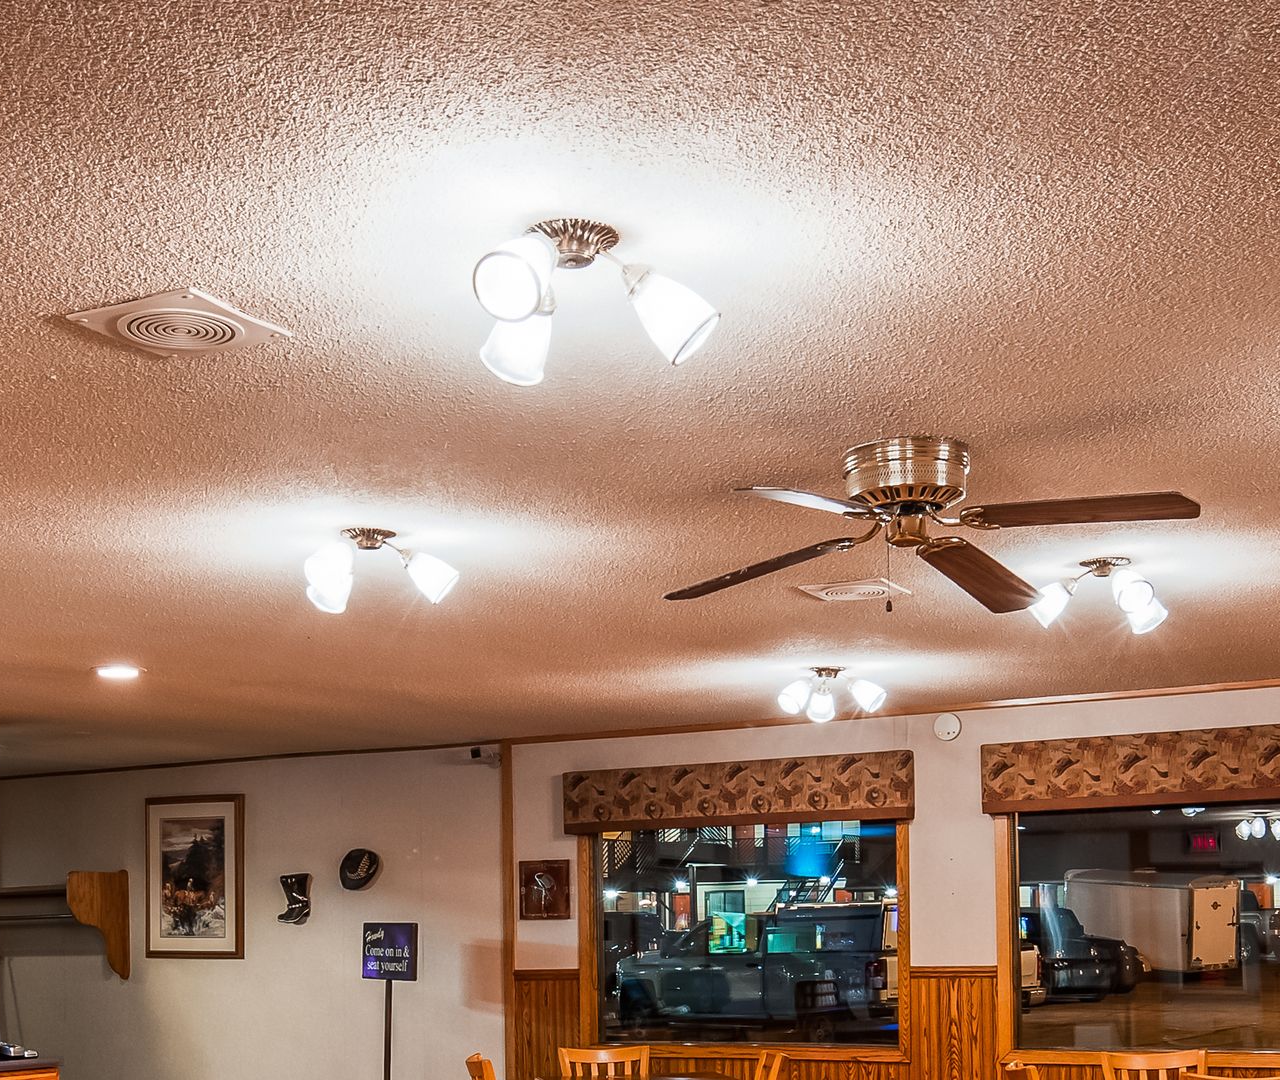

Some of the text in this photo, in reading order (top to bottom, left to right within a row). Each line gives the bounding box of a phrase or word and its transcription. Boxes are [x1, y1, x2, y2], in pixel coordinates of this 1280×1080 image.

[365, 944, 410, 957] Come on in &
[367, 960, 408, 973] seat yourself
